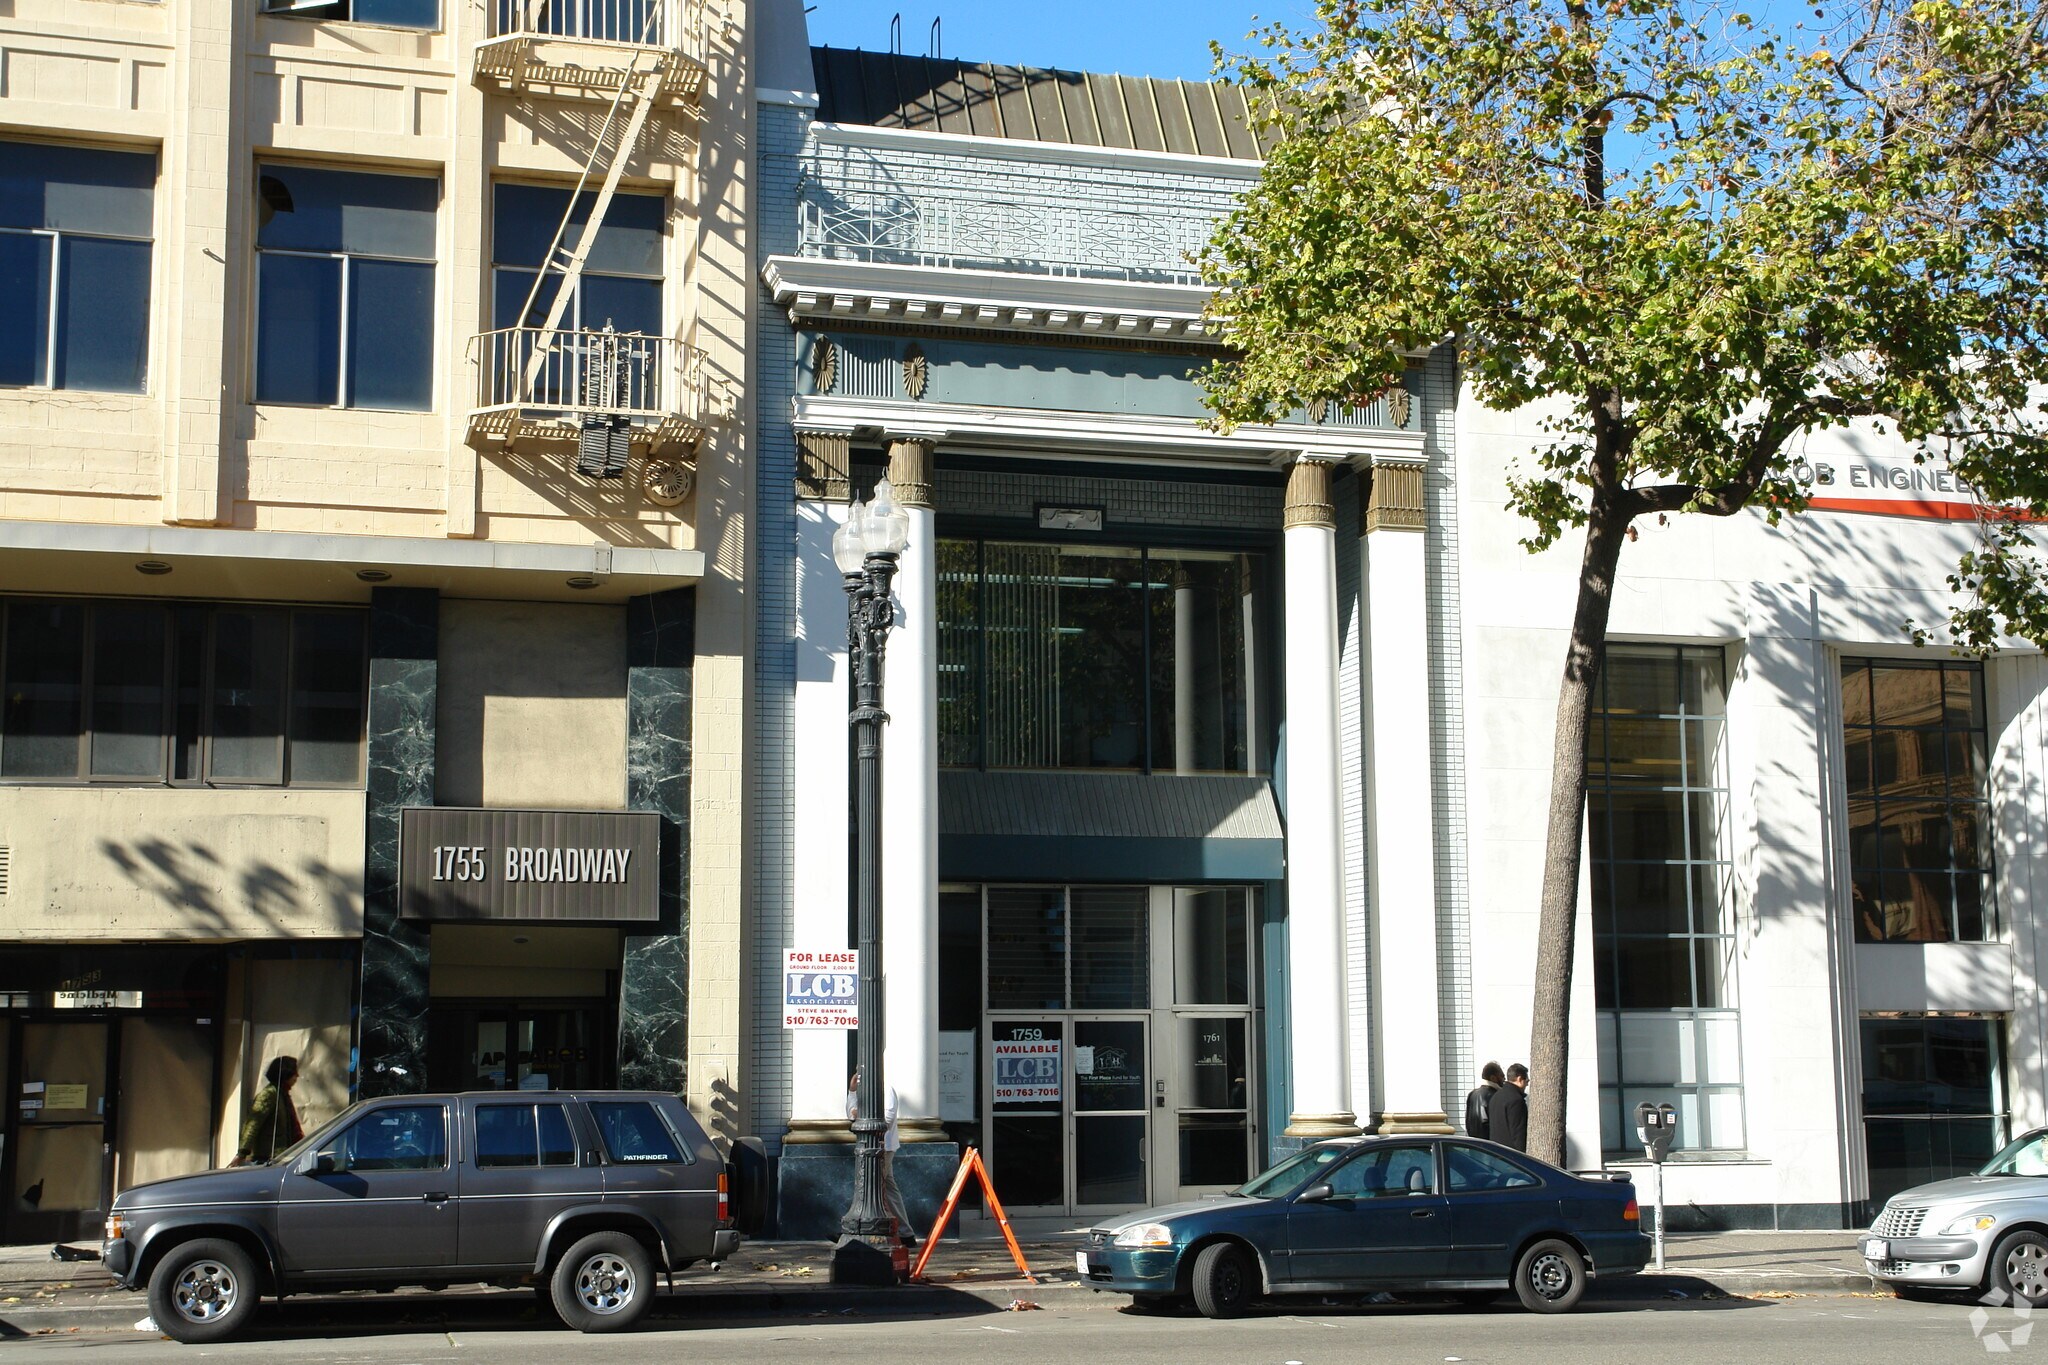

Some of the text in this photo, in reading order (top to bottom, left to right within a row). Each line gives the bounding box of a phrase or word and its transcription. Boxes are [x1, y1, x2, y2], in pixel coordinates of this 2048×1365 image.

[432, 846, 632, 883] 1755 BROADWAY
[789, 953, 855, 963] FOR LEASE
[789, 974, 855, 998] LCB
[786, 1016, 859, 1025] 510/763-7016
[1011, 1028, 1043, 1040] 1759
[1203, 1033, 1220, 1043] 1761
[995, 1045, 1059, 1054] AVAILABLE
[1000, 1058, 1055, 1078] LCB
[996, 1088, 1059, 1097] 510/763-7016
